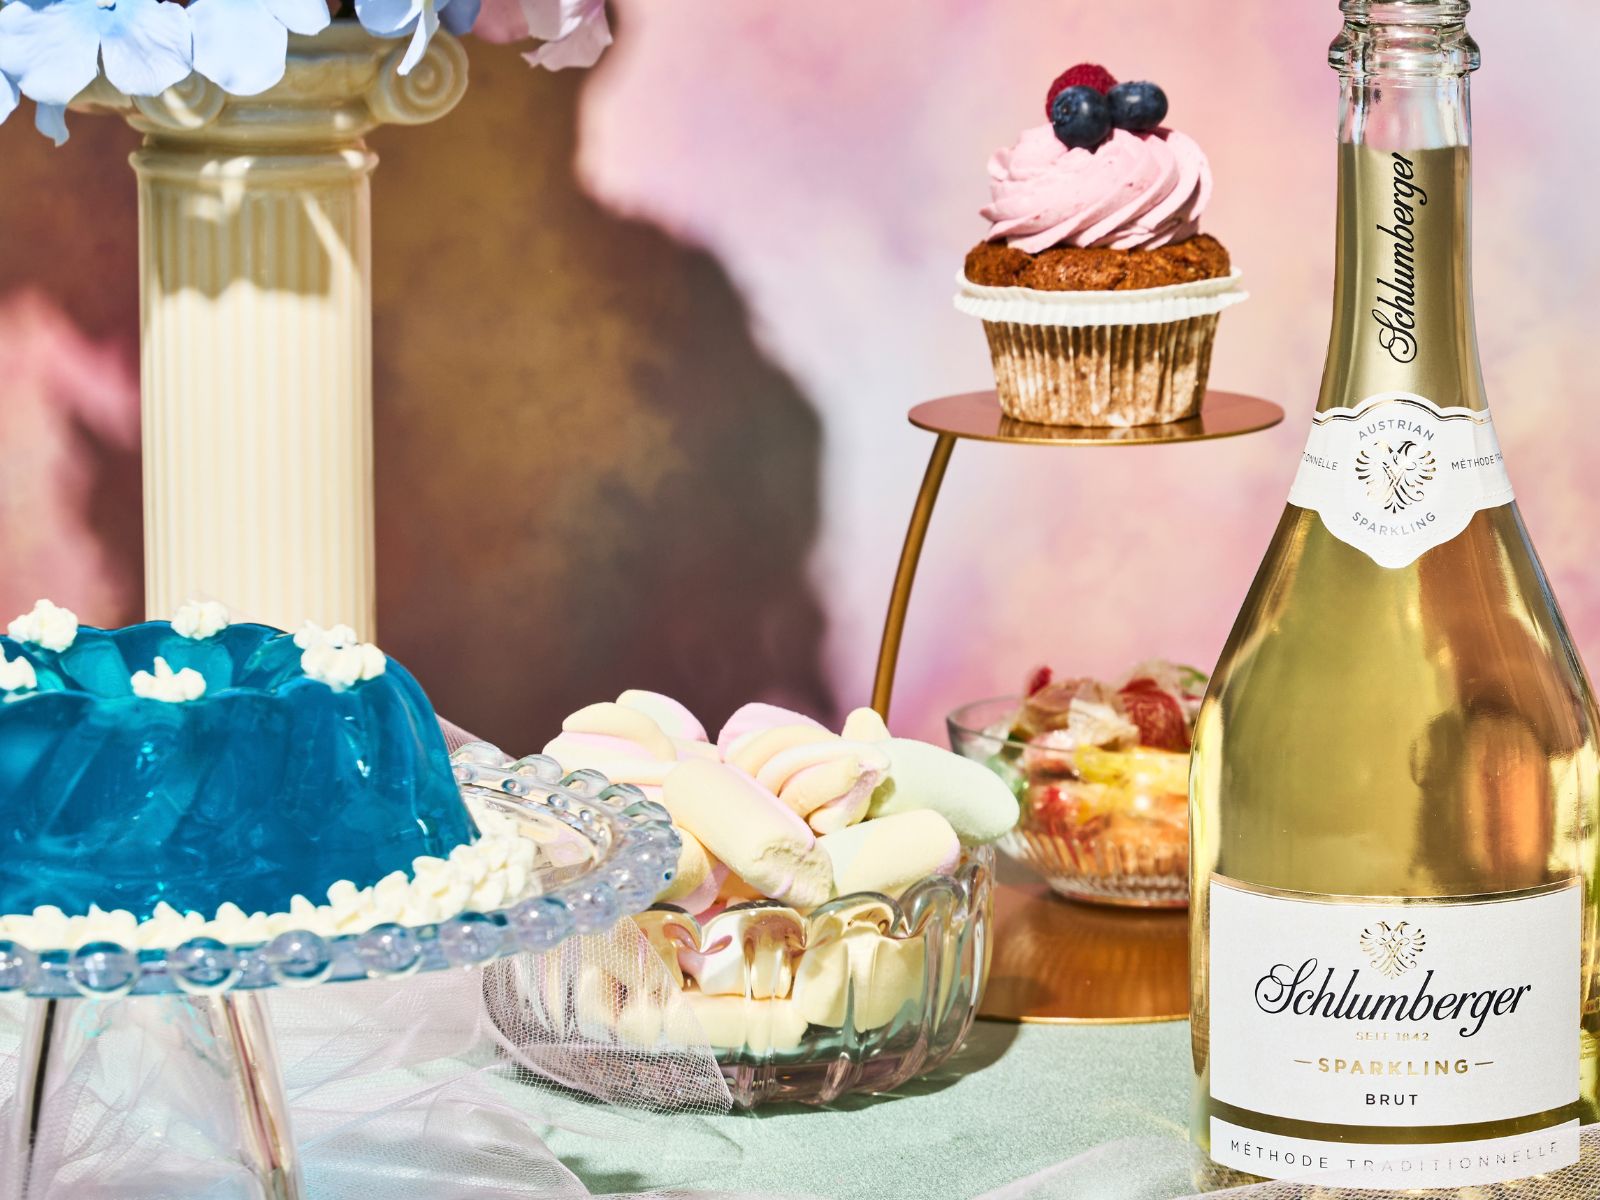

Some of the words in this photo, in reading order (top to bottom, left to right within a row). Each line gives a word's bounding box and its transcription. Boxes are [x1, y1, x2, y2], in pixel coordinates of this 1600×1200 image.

[1371, 151, 1428, 364] Schlumberger
[1358, 419, 1434, 441] AUSTRIAN
[1451, 455, 1494, 470] MÉTHODE
[1352, 511, 1436, 536] SPARKLING
[1254, 957, 1531, 1038] Schlumberger
[1365, 1093, 1419, 1106] BRUT
[1231, 1139, 1329, 1169] MÉTHODE
[1346, 1141, 1557, 1172] TRADITIONNELLE
